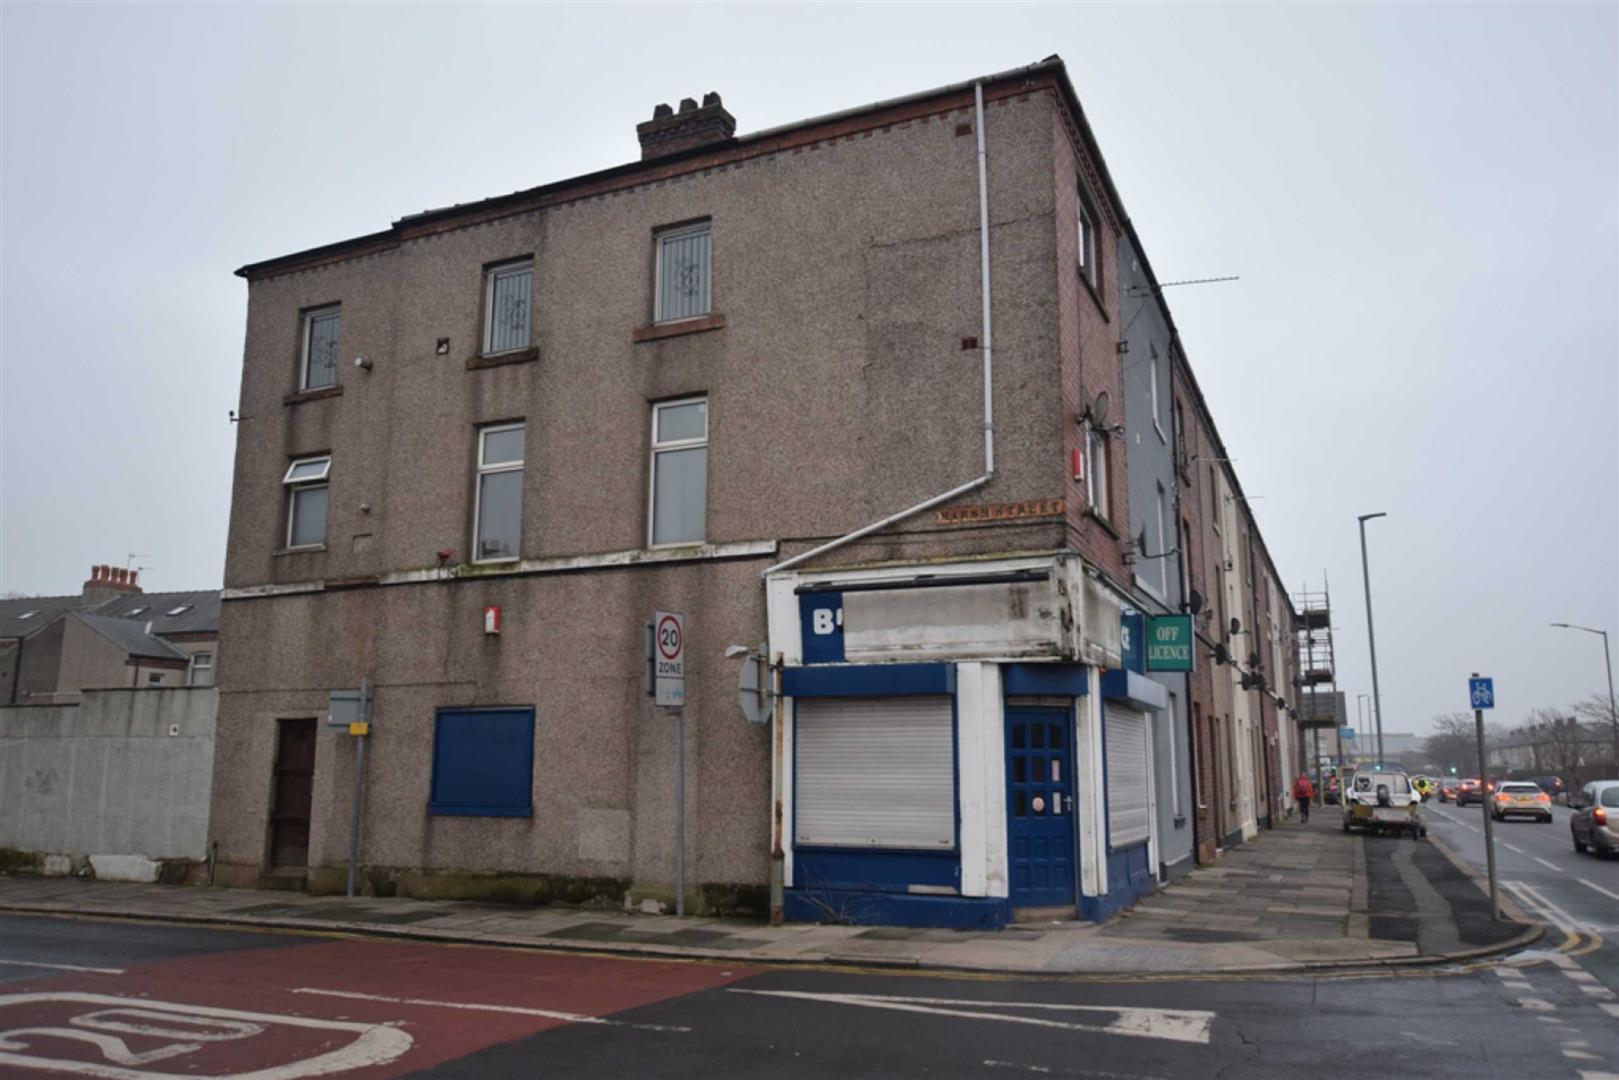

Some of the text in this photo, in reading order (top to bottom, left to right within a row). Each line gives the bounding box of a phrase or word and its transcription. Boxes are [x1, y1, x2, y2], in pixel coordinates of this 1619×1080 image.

[997, 499, 1061, 518] STREET
[661, 627, 679, 647] 20
[1156, 626, 1179, 642] OFF
[1148, 645, 1190, 660] LICENCE
[658, 662, 682, 674] ZONE
